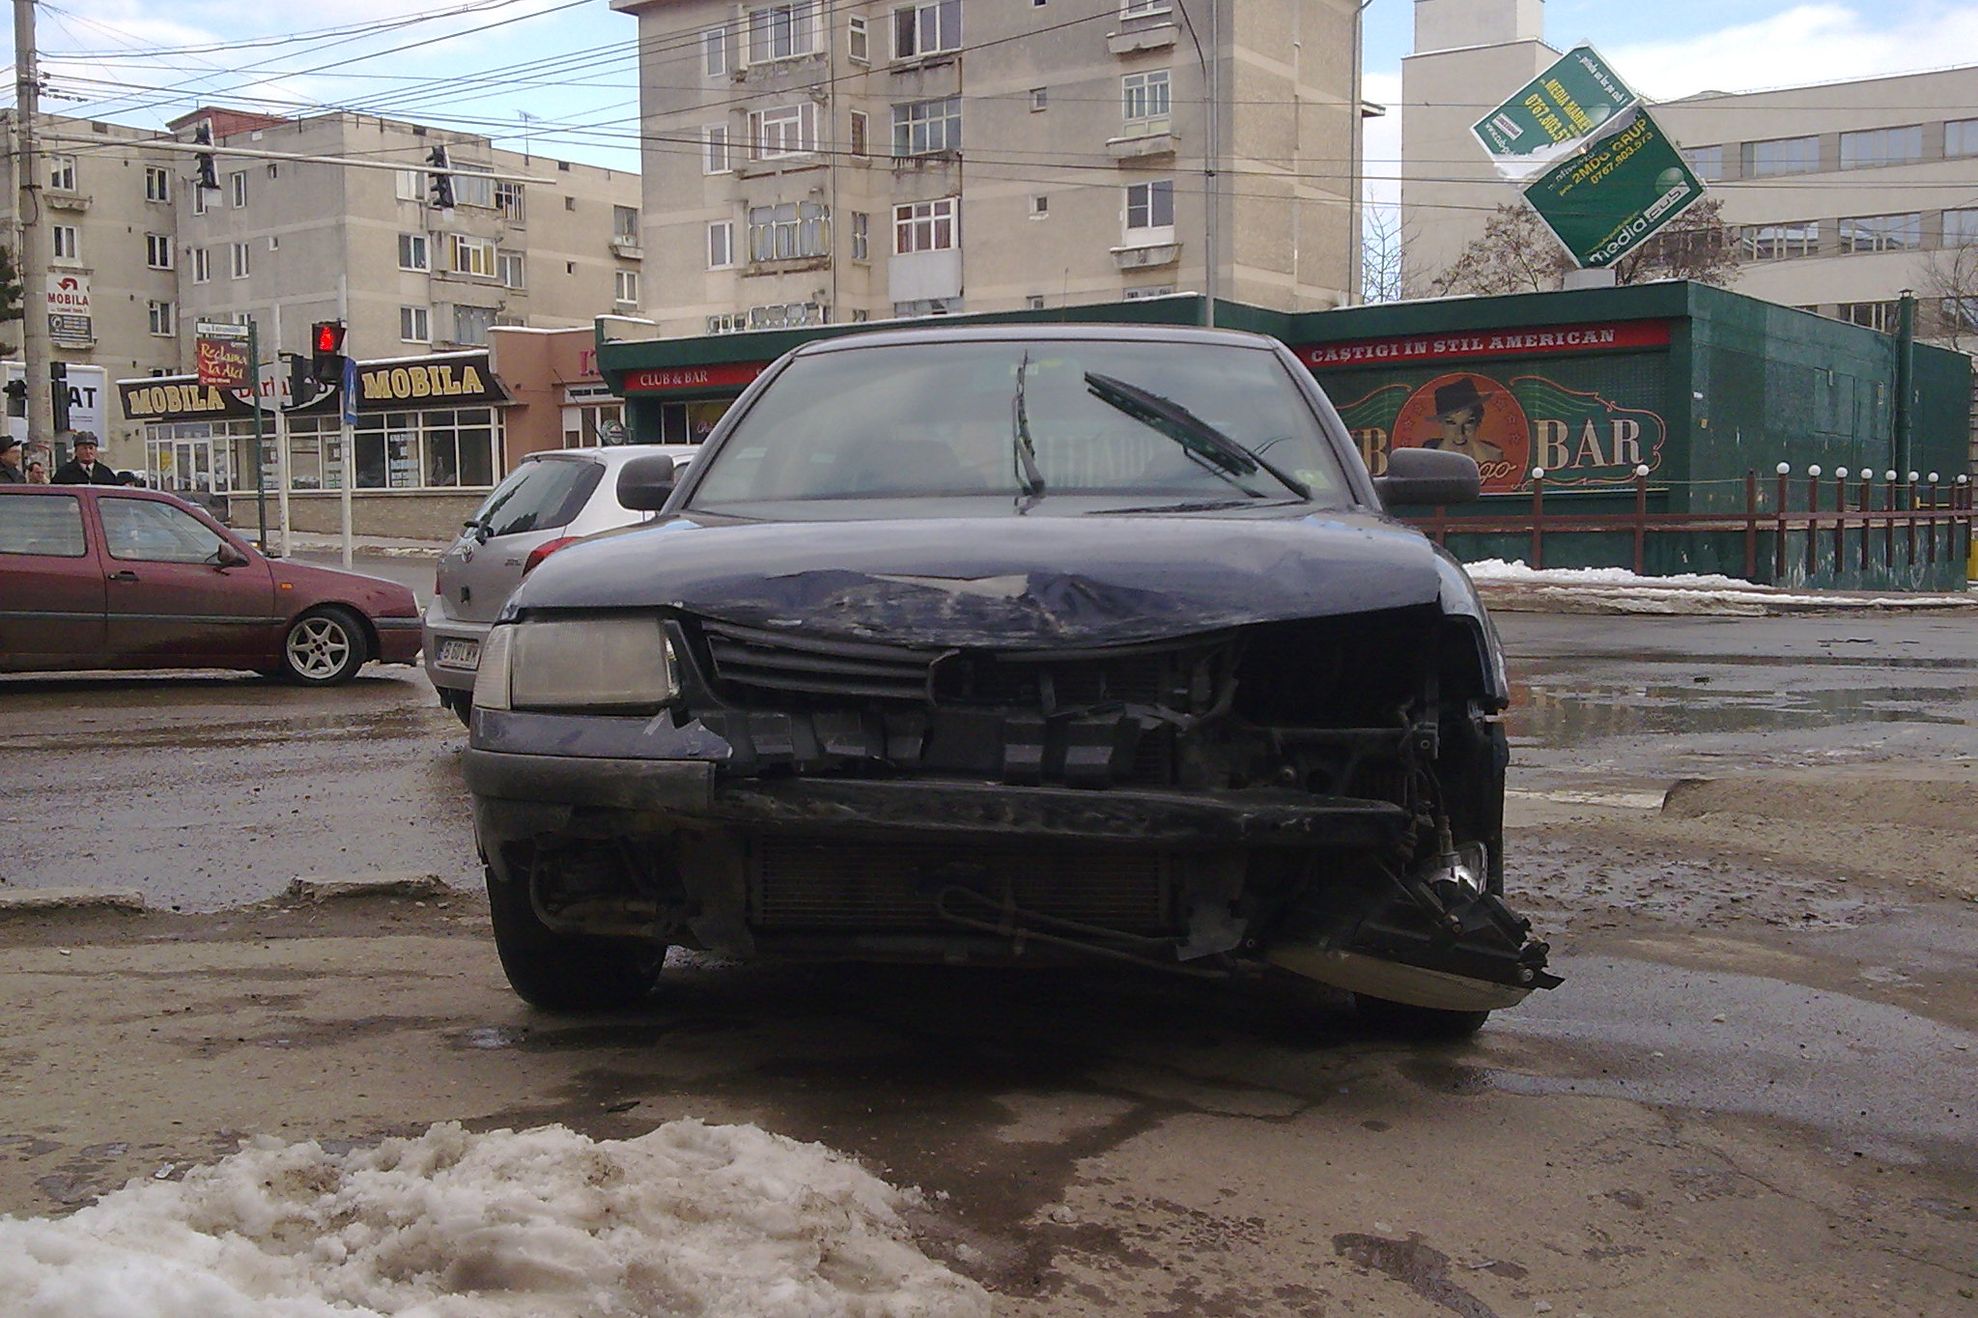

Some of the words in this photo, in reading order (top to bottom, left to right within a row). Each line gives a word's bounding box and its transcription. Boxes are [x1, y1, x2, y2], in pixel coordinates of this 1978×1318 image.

[48, 293, 89, 306] MOBILA
[201, 343, 247, 365] Reclama
[1404, 340, 1429, 355] IN
[1433, 337, 1484, 352] STIL
[1488, 329, 1616, 349] AMERICAN
[361, 365, 485, 399] MOBILA
[640, 373, 670, 386] CLUB
[672, 375, 682, 385] &
[684, 370, 708, 384] BAR
[128, 385, 226, 414] MOBILA
[1533, 418, 1644, 471] BAR
